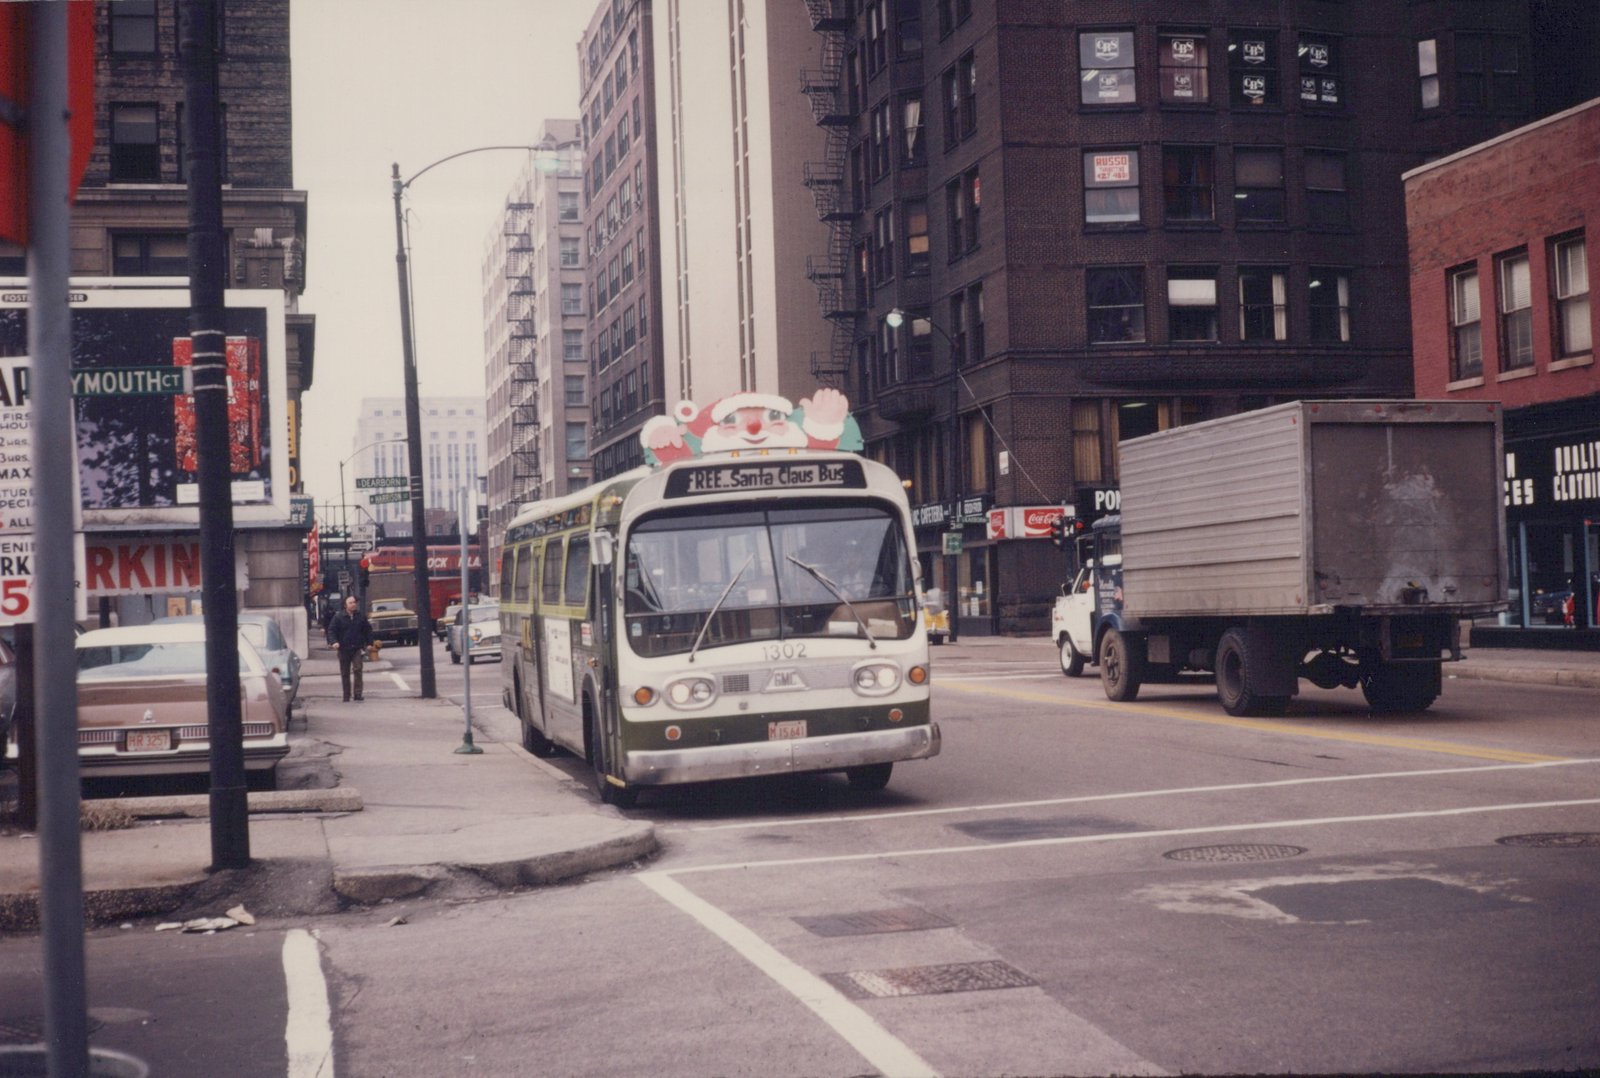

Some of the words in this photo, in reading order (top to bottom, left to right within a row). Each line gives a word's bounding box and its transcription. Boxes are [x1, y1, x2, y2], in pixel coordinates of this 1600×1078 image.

[1173, 41, 1194, 54] CBS
[1244, 43, 1264, 56] CBS
[1244, 77, 1264, 90] CBS
[71, 370, 161, 394] YMOUTH
[162, 374, 180, 388] CT
[0, 421, 29, 430] HOU
[0, 467, 32, 480] MAX
[730, 468, 773, 488] Santa
[778, 466, 813, 485] Claus
[818, 463, 844, 482] Bus
[361, 478, 400, 489] DEARBORN
[1553, 471, 1600, 501] CLOTHI
[762, 643, 807, 661] 1302
